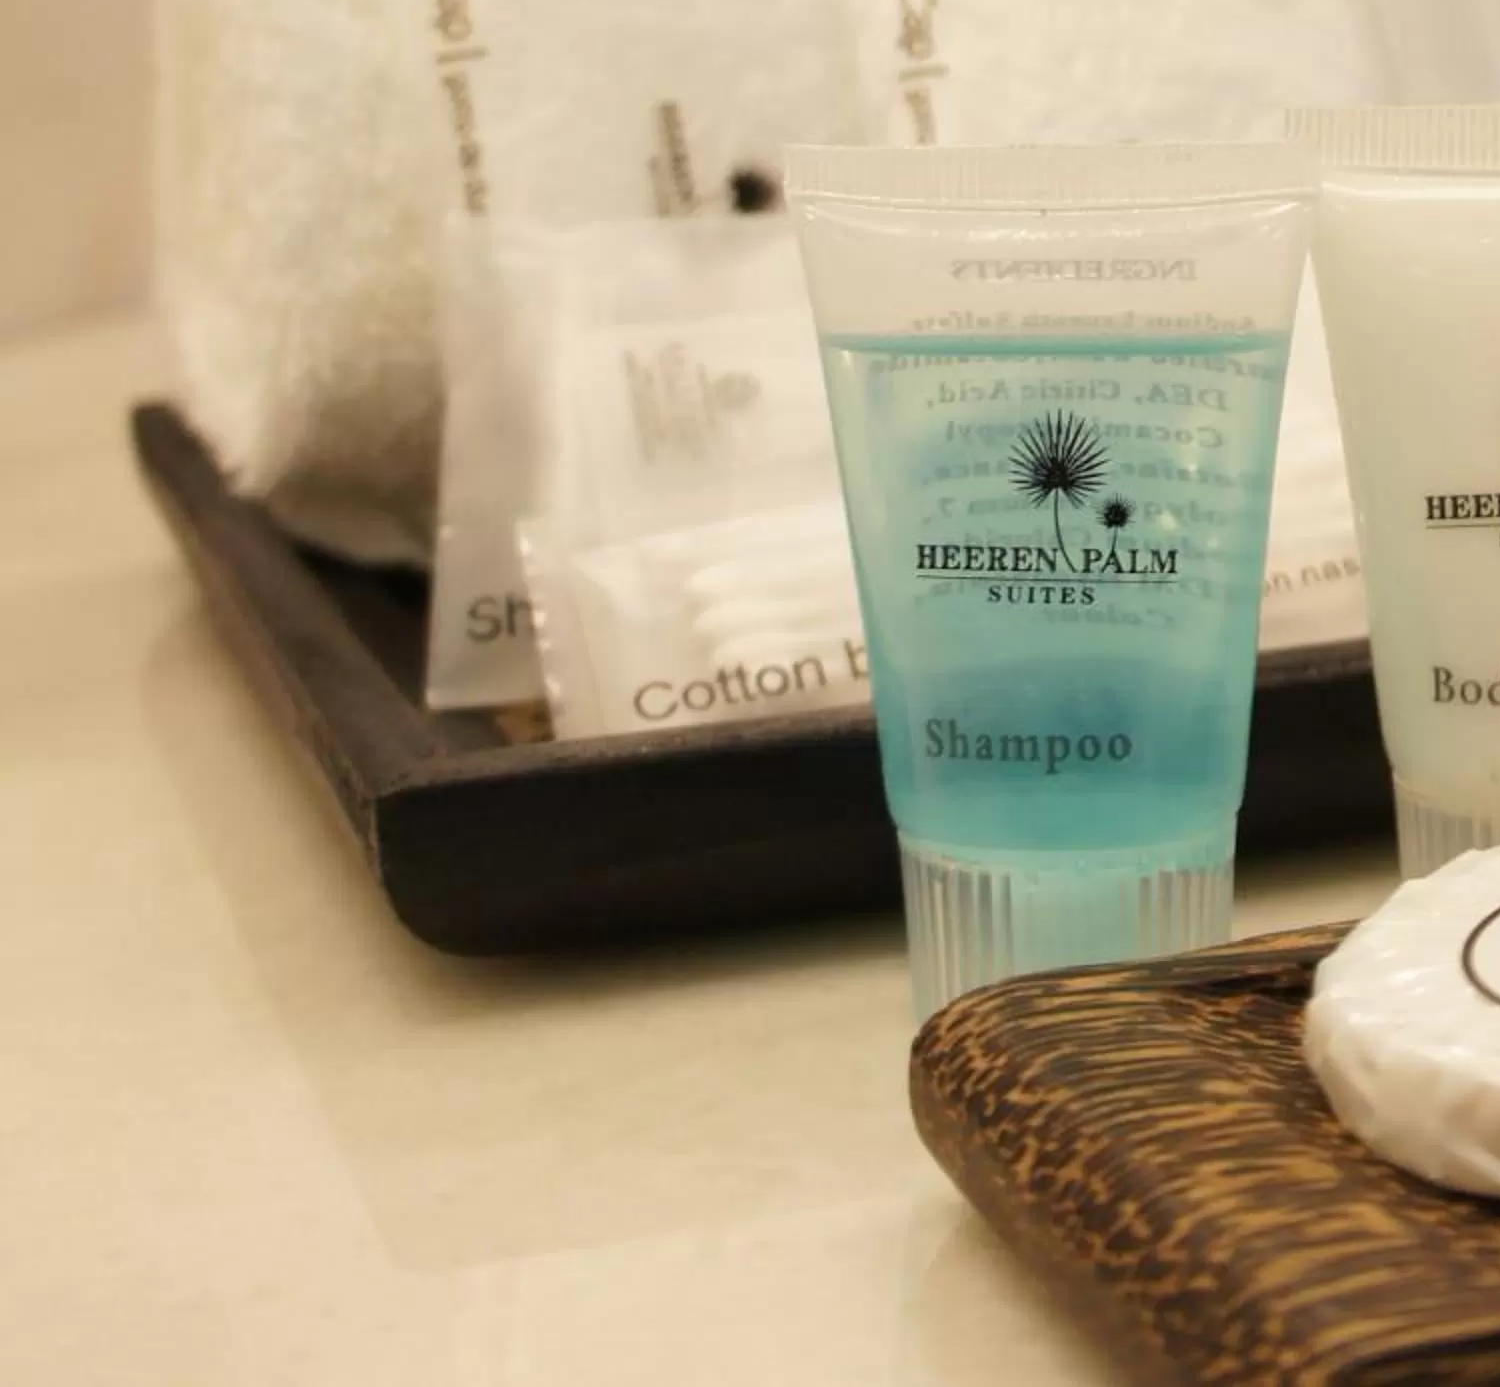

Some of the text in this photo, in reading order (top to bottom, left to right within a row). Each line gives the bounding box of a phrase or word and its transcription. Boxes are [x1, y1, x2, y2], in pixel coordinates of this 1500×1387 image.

[916, 544, 1178, 575] HEEREN PALM
[988, 586, 1096, 606] SUITES
[633, 655, 826, 721] Cotton
[925, 719, 1132, 774] Shampoo
